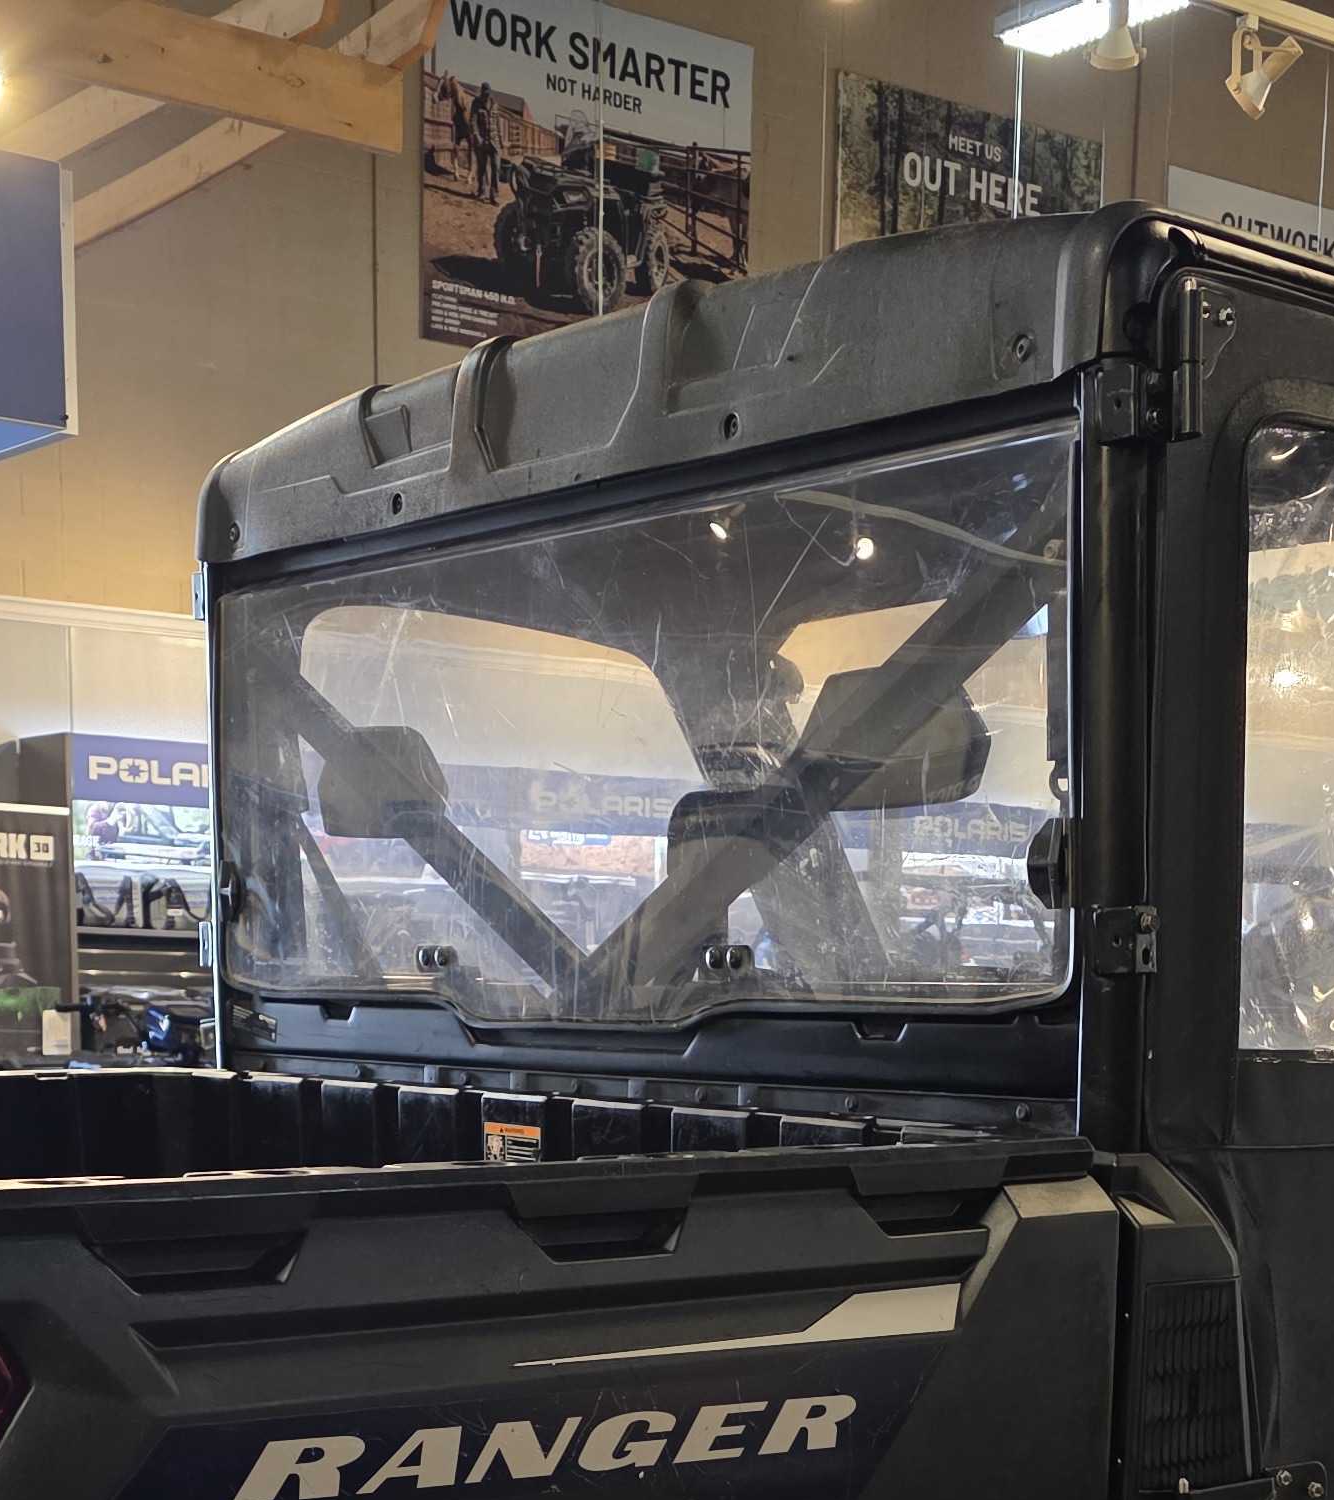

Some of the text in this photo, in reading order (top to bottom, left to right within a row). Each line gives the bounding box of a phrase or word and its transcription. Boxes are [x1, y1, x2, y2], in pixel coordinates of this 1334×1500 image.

[450, 0, 731, 109] WORK SMARTER
[546, 73, 642, 114] NOT HARDER
[948, 133, 1003, 163] MEET US
[903, 151, 1043, 217] OUT HERE
[89, 754, 208, 788] POLA
